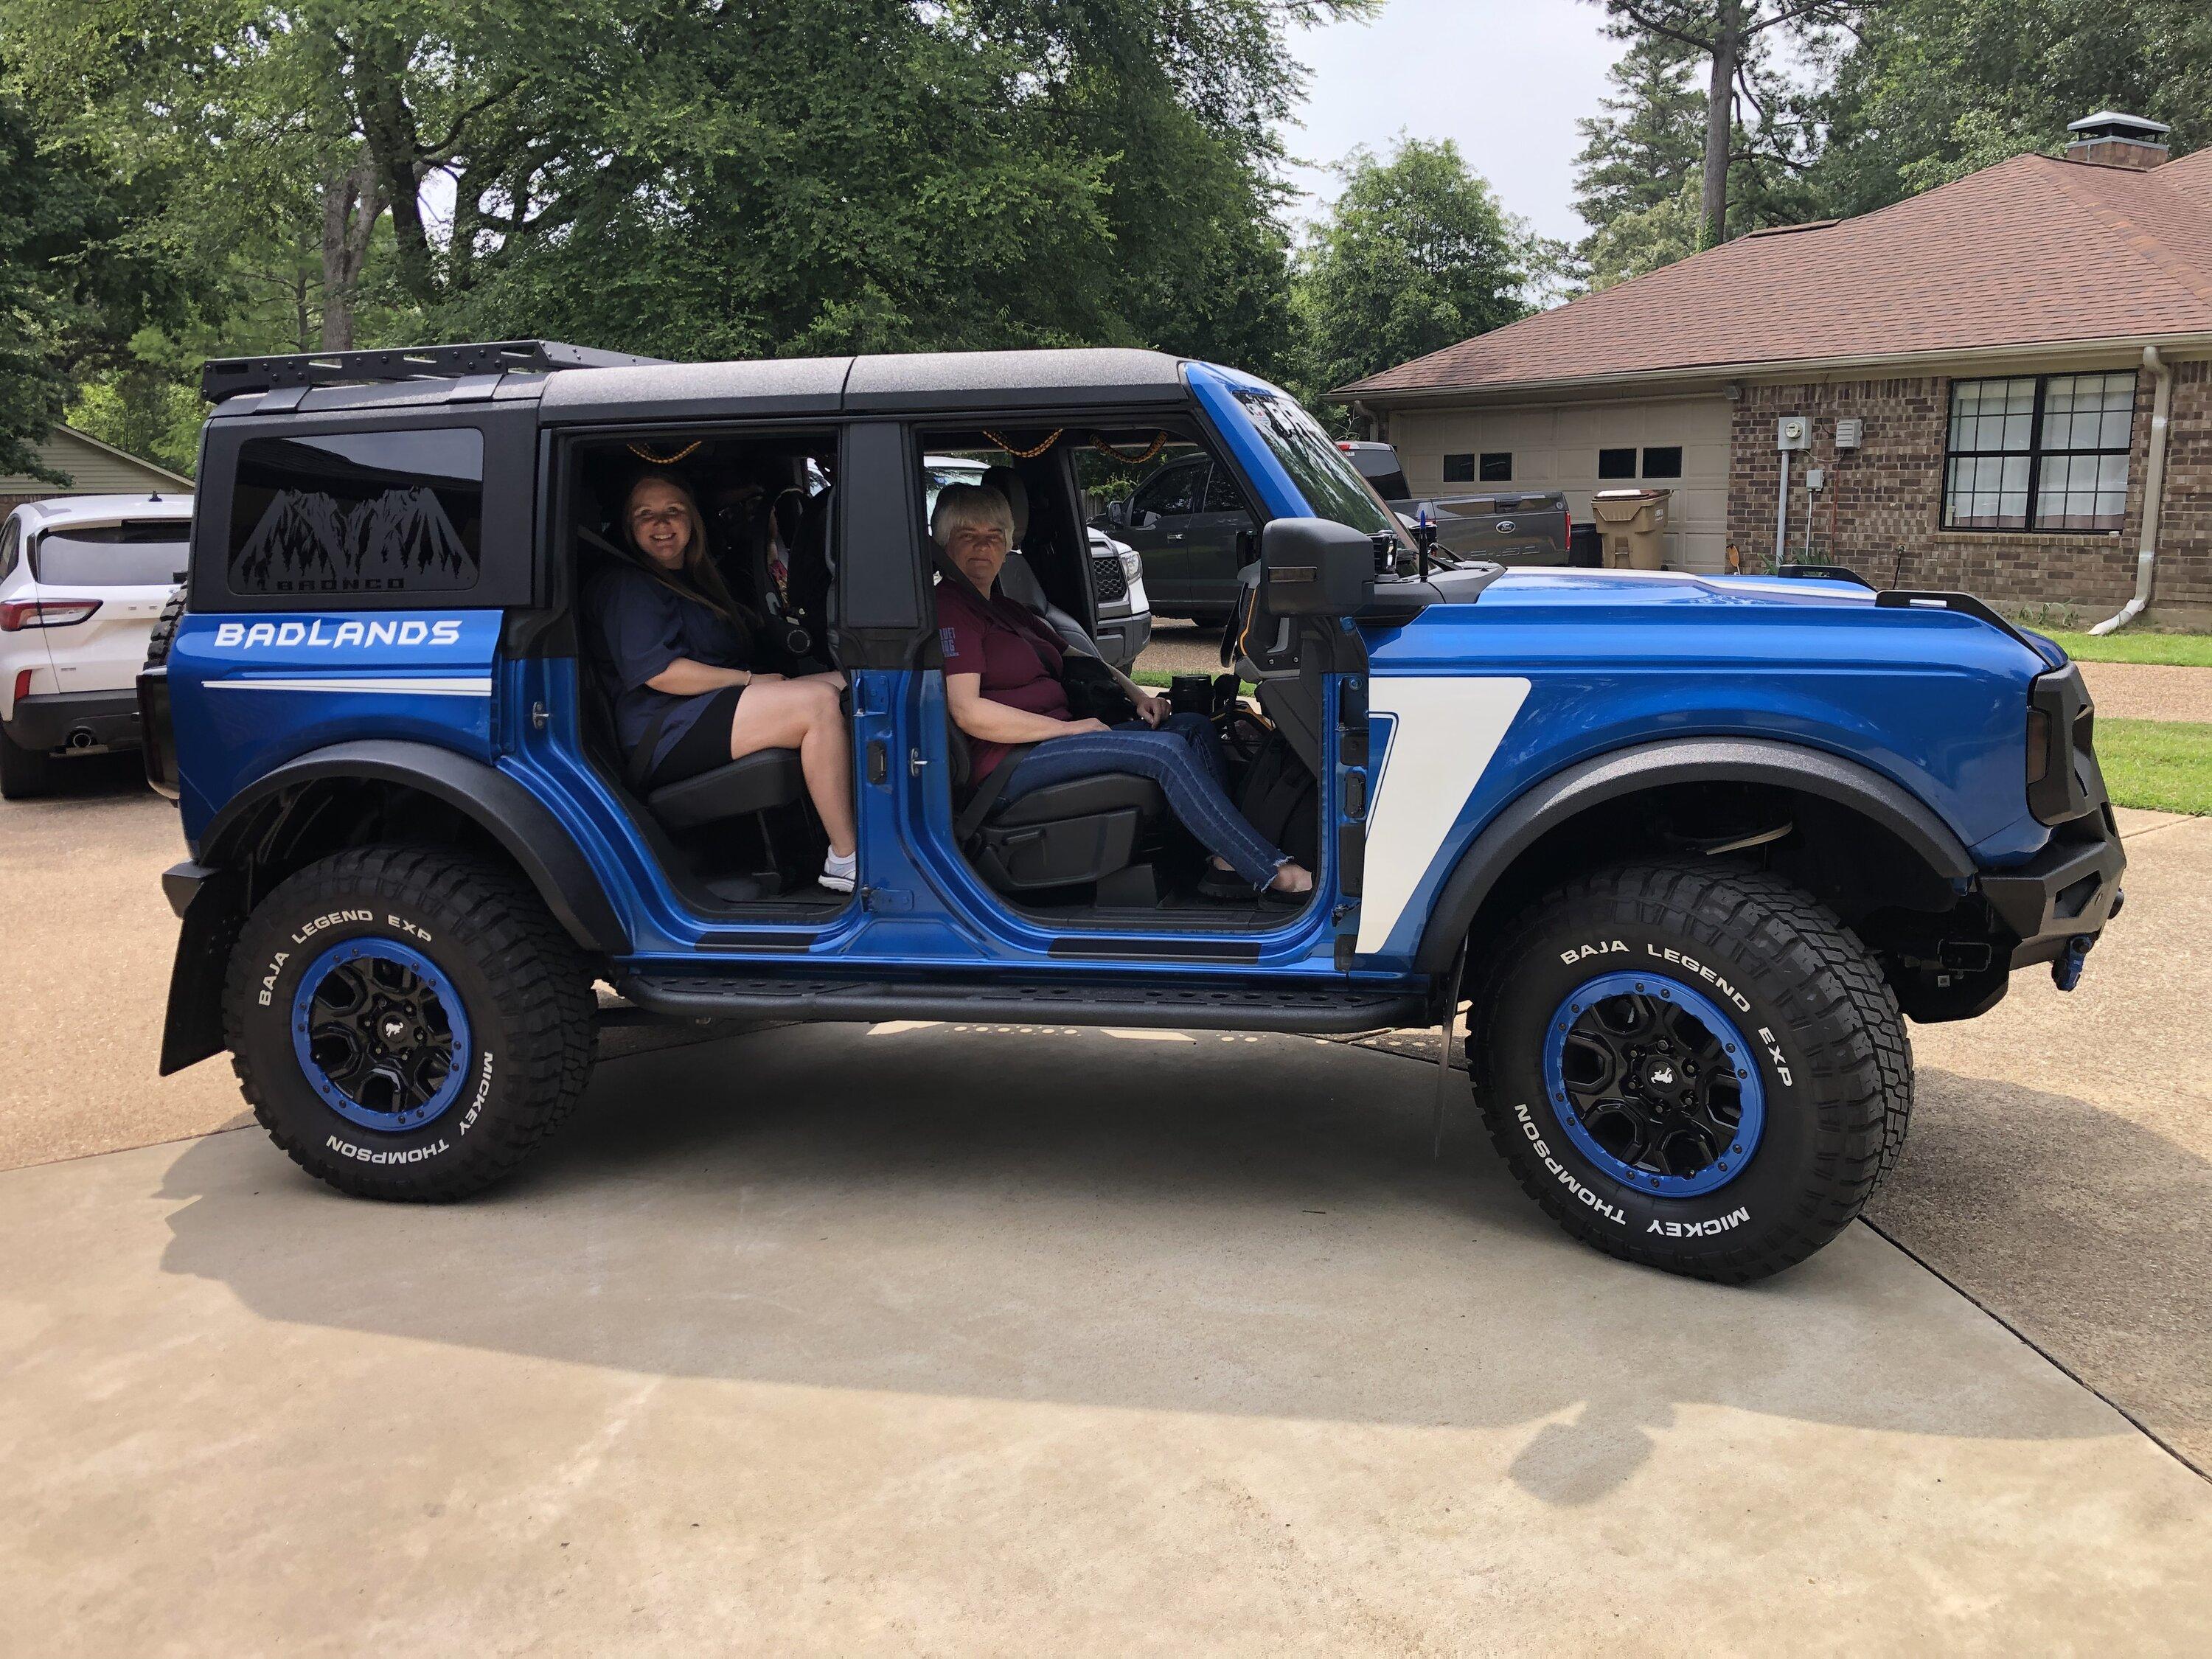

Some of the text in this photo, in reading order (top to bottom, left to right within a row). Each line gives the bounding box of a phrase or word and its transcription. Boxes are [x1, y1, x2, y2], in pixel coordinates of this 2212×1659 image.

[214, 619, 463, 650] BADLANDS
[276, 578, 404, 590] BRONCO
[257, 909, 433, 1007] BAJA LEGEND EXP
[1559, 939, 1794, 1088] BAJA LEGEND EXP
[325, 1051, 494, 1165] MICKEY THOMPSON
[1513, 1103, 1751, 1239] MICKEY THOMPSON
